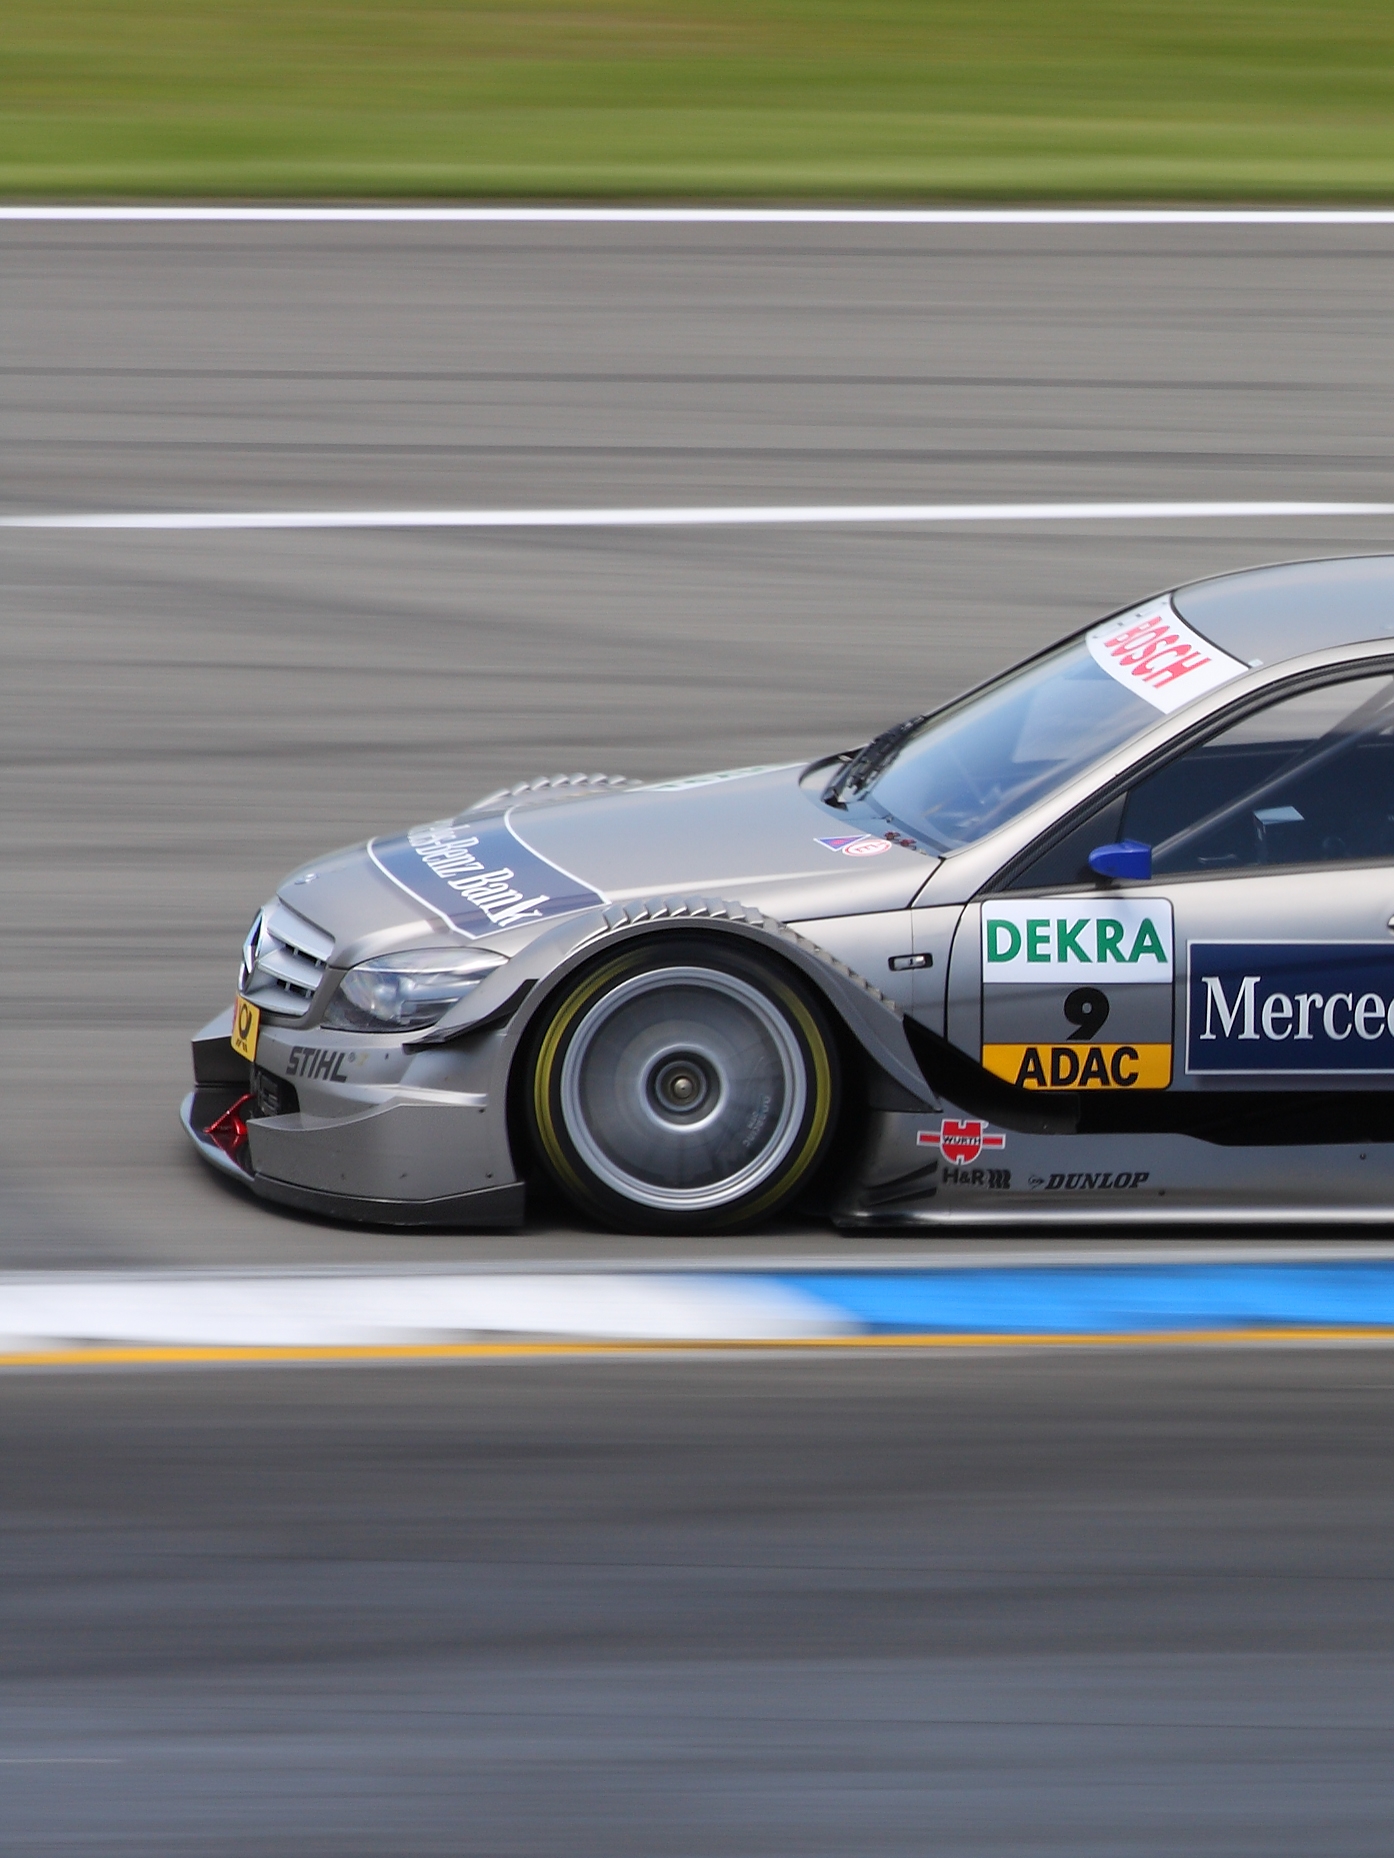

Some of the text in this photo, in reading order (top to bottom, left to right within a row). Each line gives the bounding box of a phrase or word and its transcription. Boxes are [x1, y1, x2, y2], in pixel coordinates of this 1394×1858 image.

[1104, 616, 1212, 689] BOSCH
[447, 867, 550, 927] Bank
[986, 917, 1169, 963] DEKRA
[1063, 986, 1110, 1041] 9
[285, 1045, 348, 1083] STIHL
[1015, 1046, 1139, 1087] ADAC
[942, 1168, 983, 1186] H&R
[1045, 1171, 1150, 1190] DUNLOP
